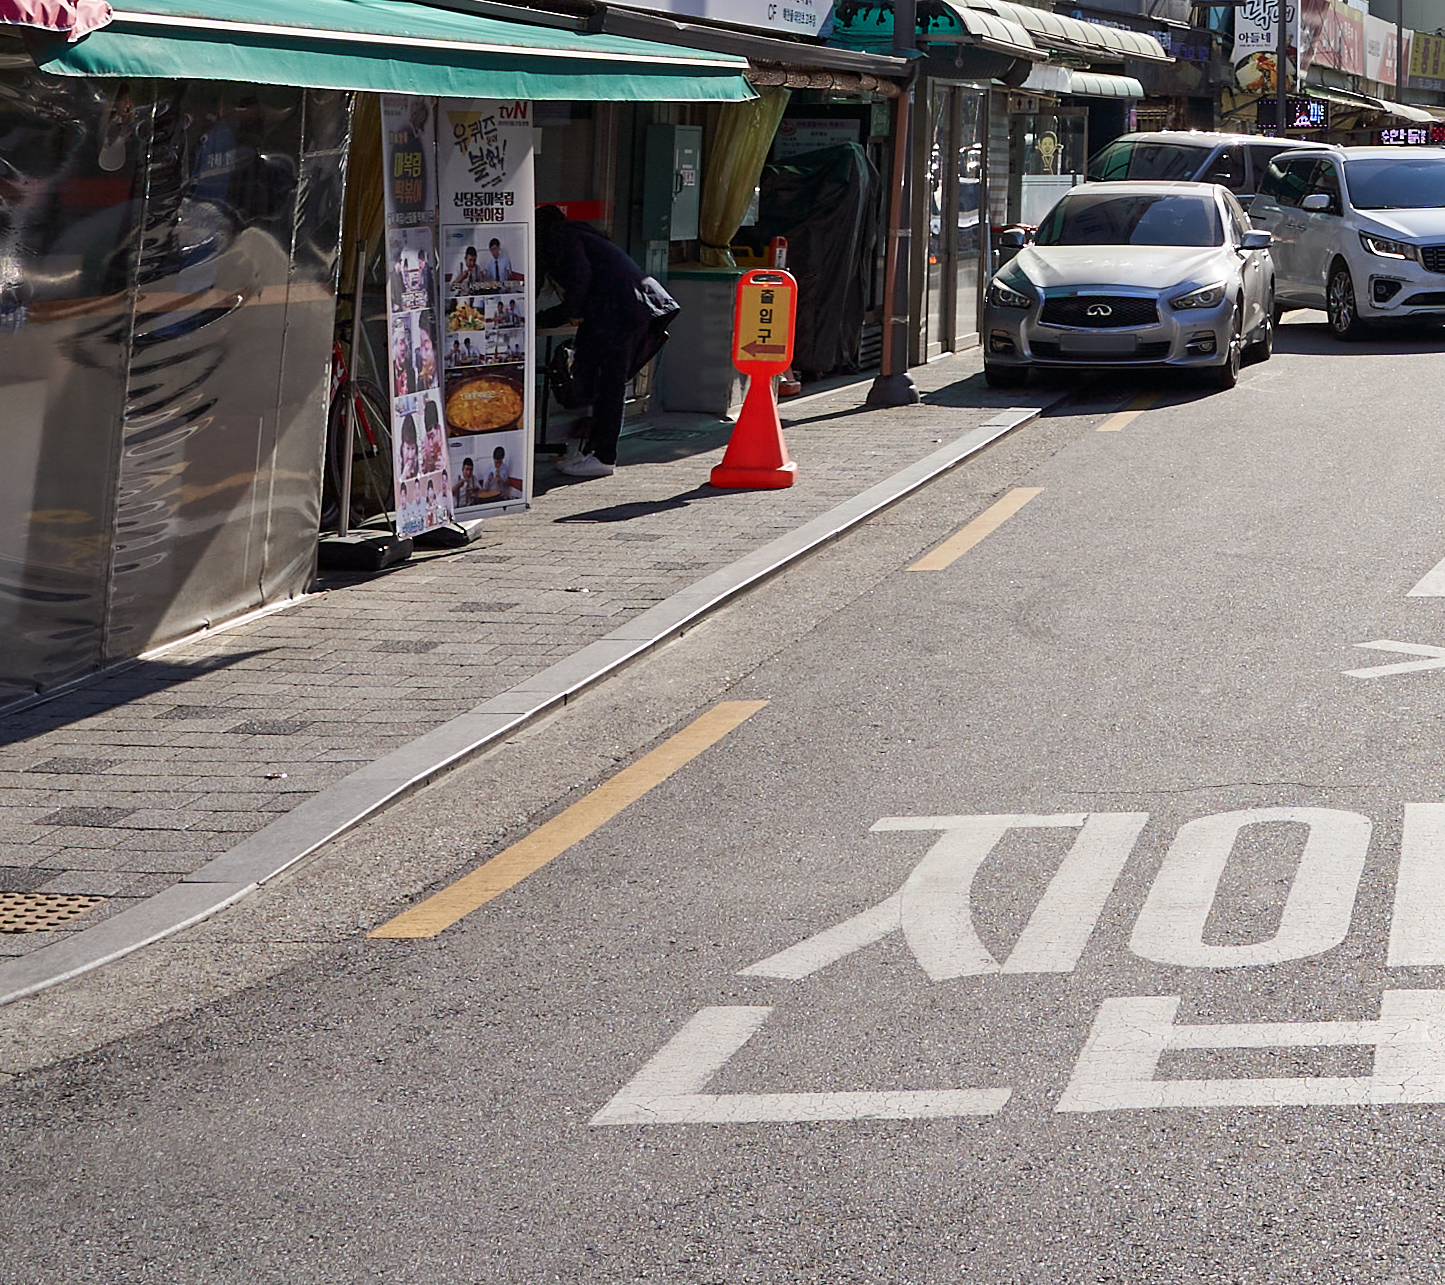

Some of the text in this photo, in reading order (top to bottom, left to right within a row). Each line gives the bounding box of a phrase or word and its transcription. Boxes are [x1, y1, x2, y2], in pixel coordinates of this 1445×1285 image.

[1237, 33, 1272, 45] 아들네
[499, 101, 528, 119] tvN
[757, 289, 775, 344] 출입구
